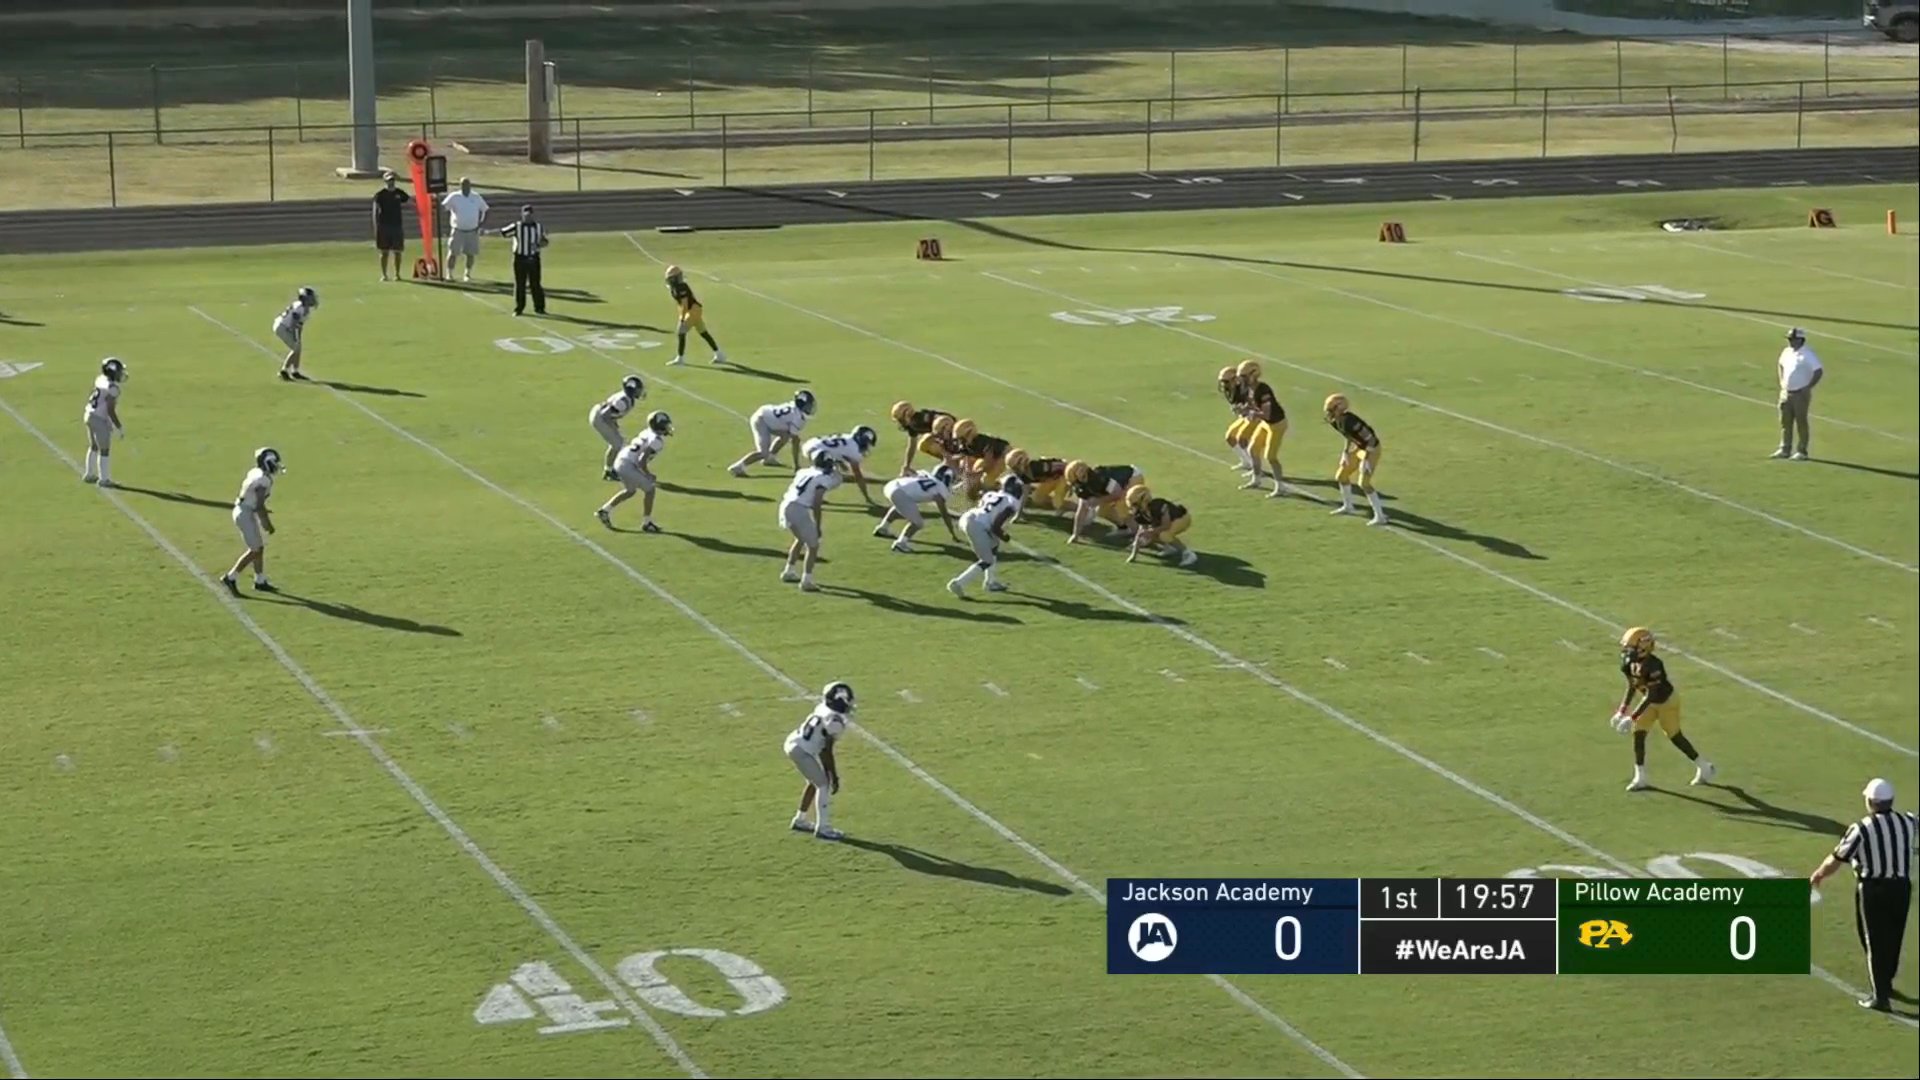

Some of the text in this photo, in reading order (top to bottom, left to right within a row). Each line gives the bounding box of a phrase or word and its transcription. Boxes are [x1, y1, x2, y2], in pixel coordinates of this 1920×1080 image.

[1815, 209, 1834, 226] G
[1386, 223, 1403, 242] 10
[919, 239, 941, 259] 20
[473, 948, 788, 1035] 40
